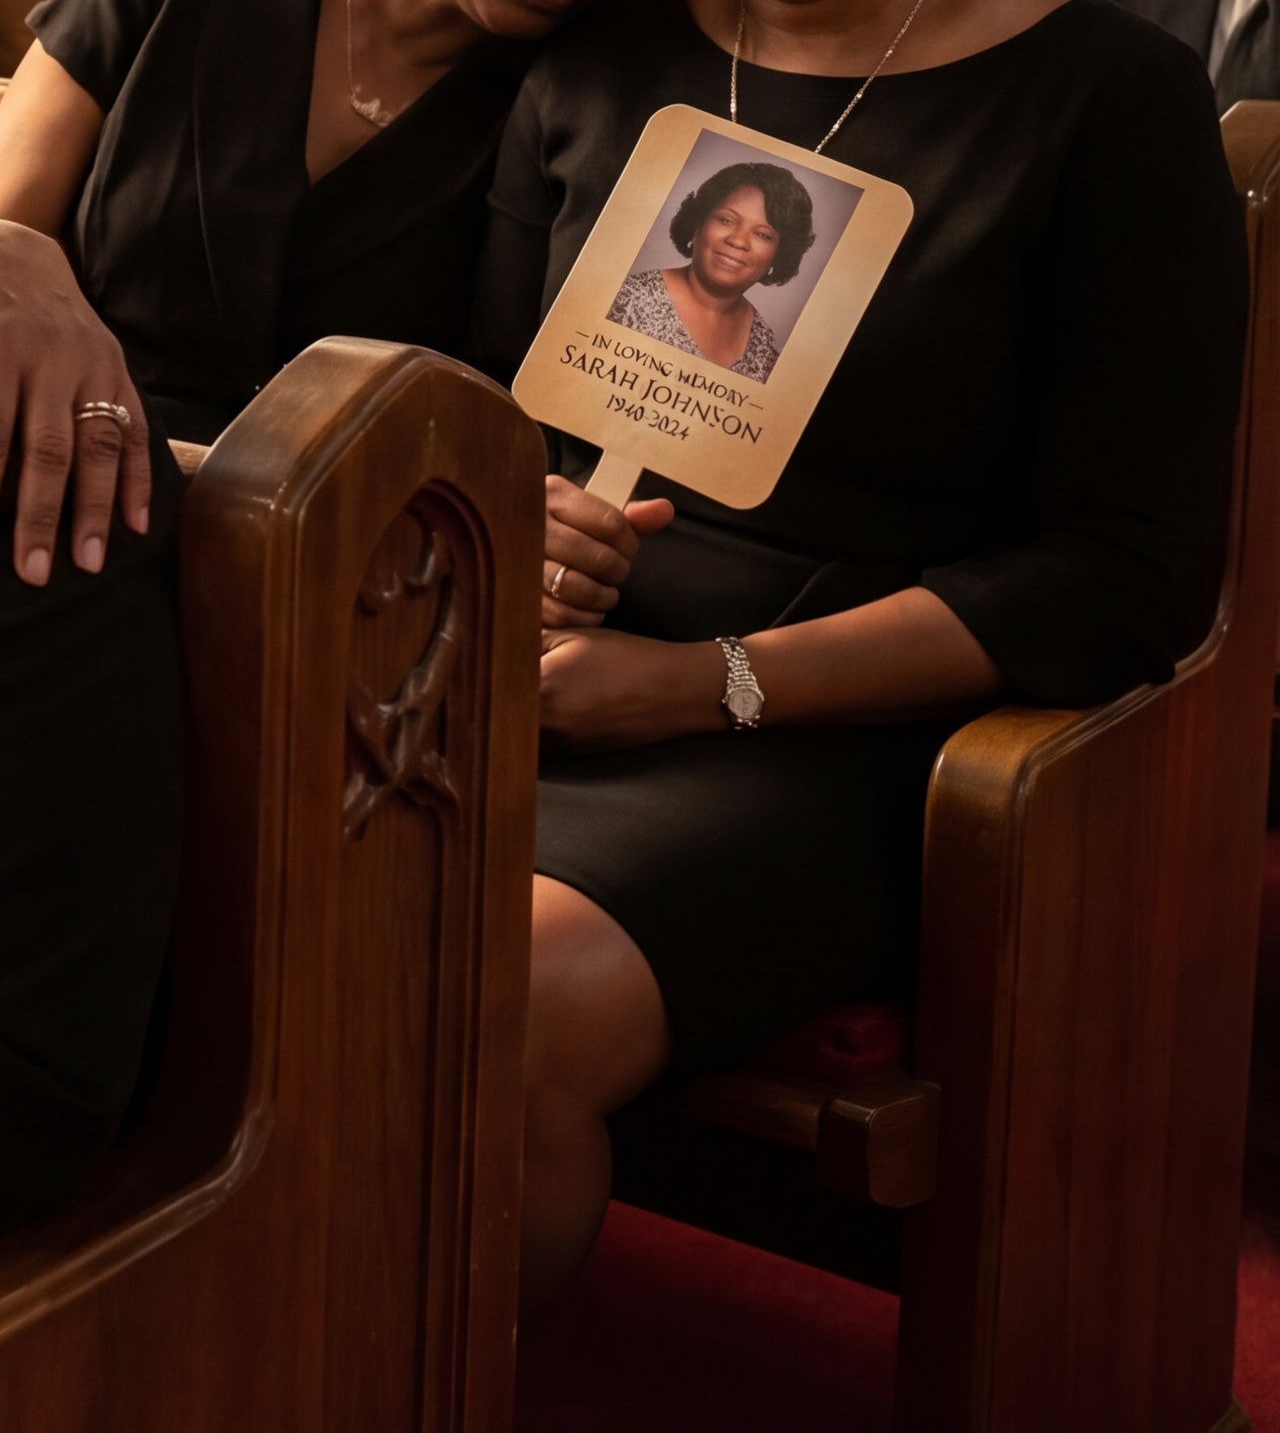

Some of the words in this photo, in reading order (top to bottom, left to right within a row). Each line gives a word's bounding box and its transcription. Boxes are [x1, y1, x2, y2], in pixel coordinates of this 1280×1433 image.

[614, 342, 674, 377] LOVING
[559, 344, 639, 391] SARAH
[641, 379, 763, 444] JOHNSON
